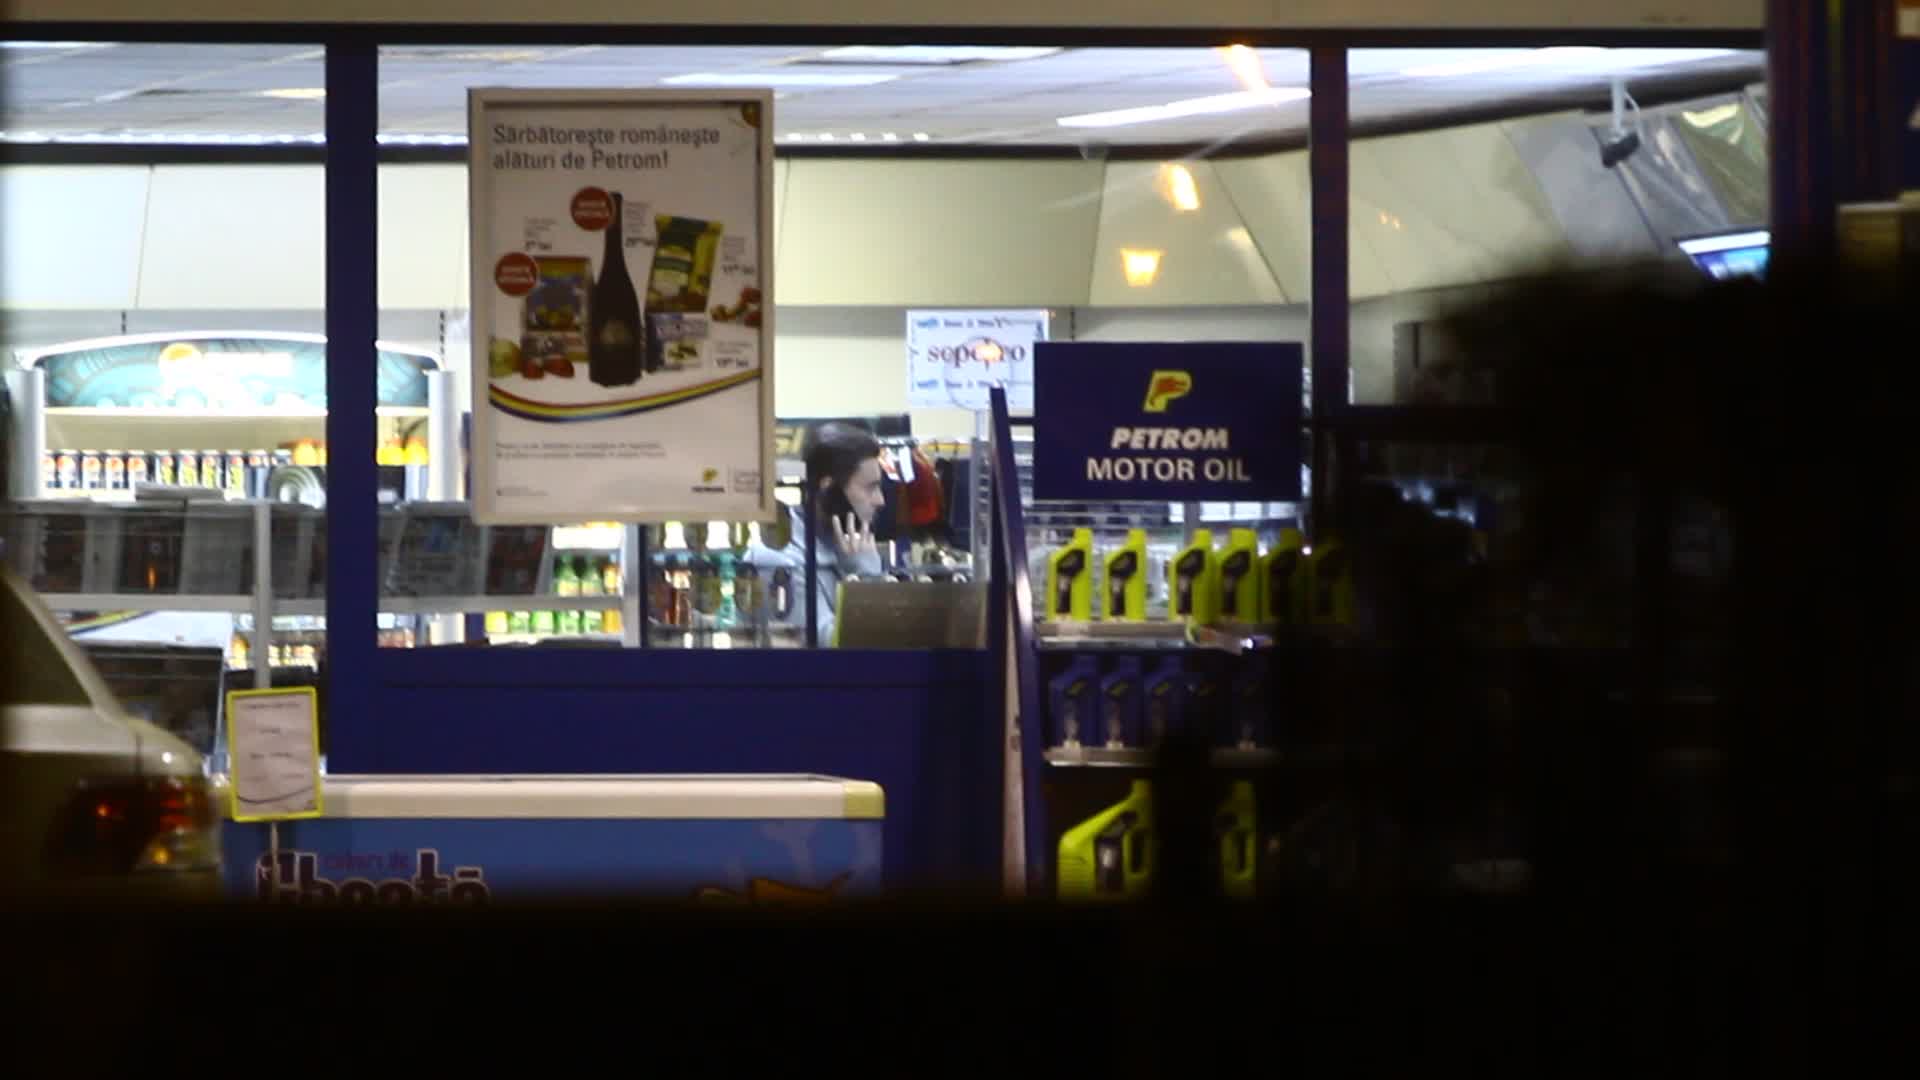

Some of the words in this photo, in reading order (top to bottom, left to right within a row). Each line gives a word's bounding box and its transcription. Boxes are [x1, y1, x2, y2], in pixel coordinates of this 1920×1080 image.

[561, 150, 585, 170] de
[591, 150, 669, 170] Petrom!
[1110, 427, 1229, 450] PETROM
[1086, 458, 1195, 482] MOTOR
[1203, 458, 1251, 482] OIL
